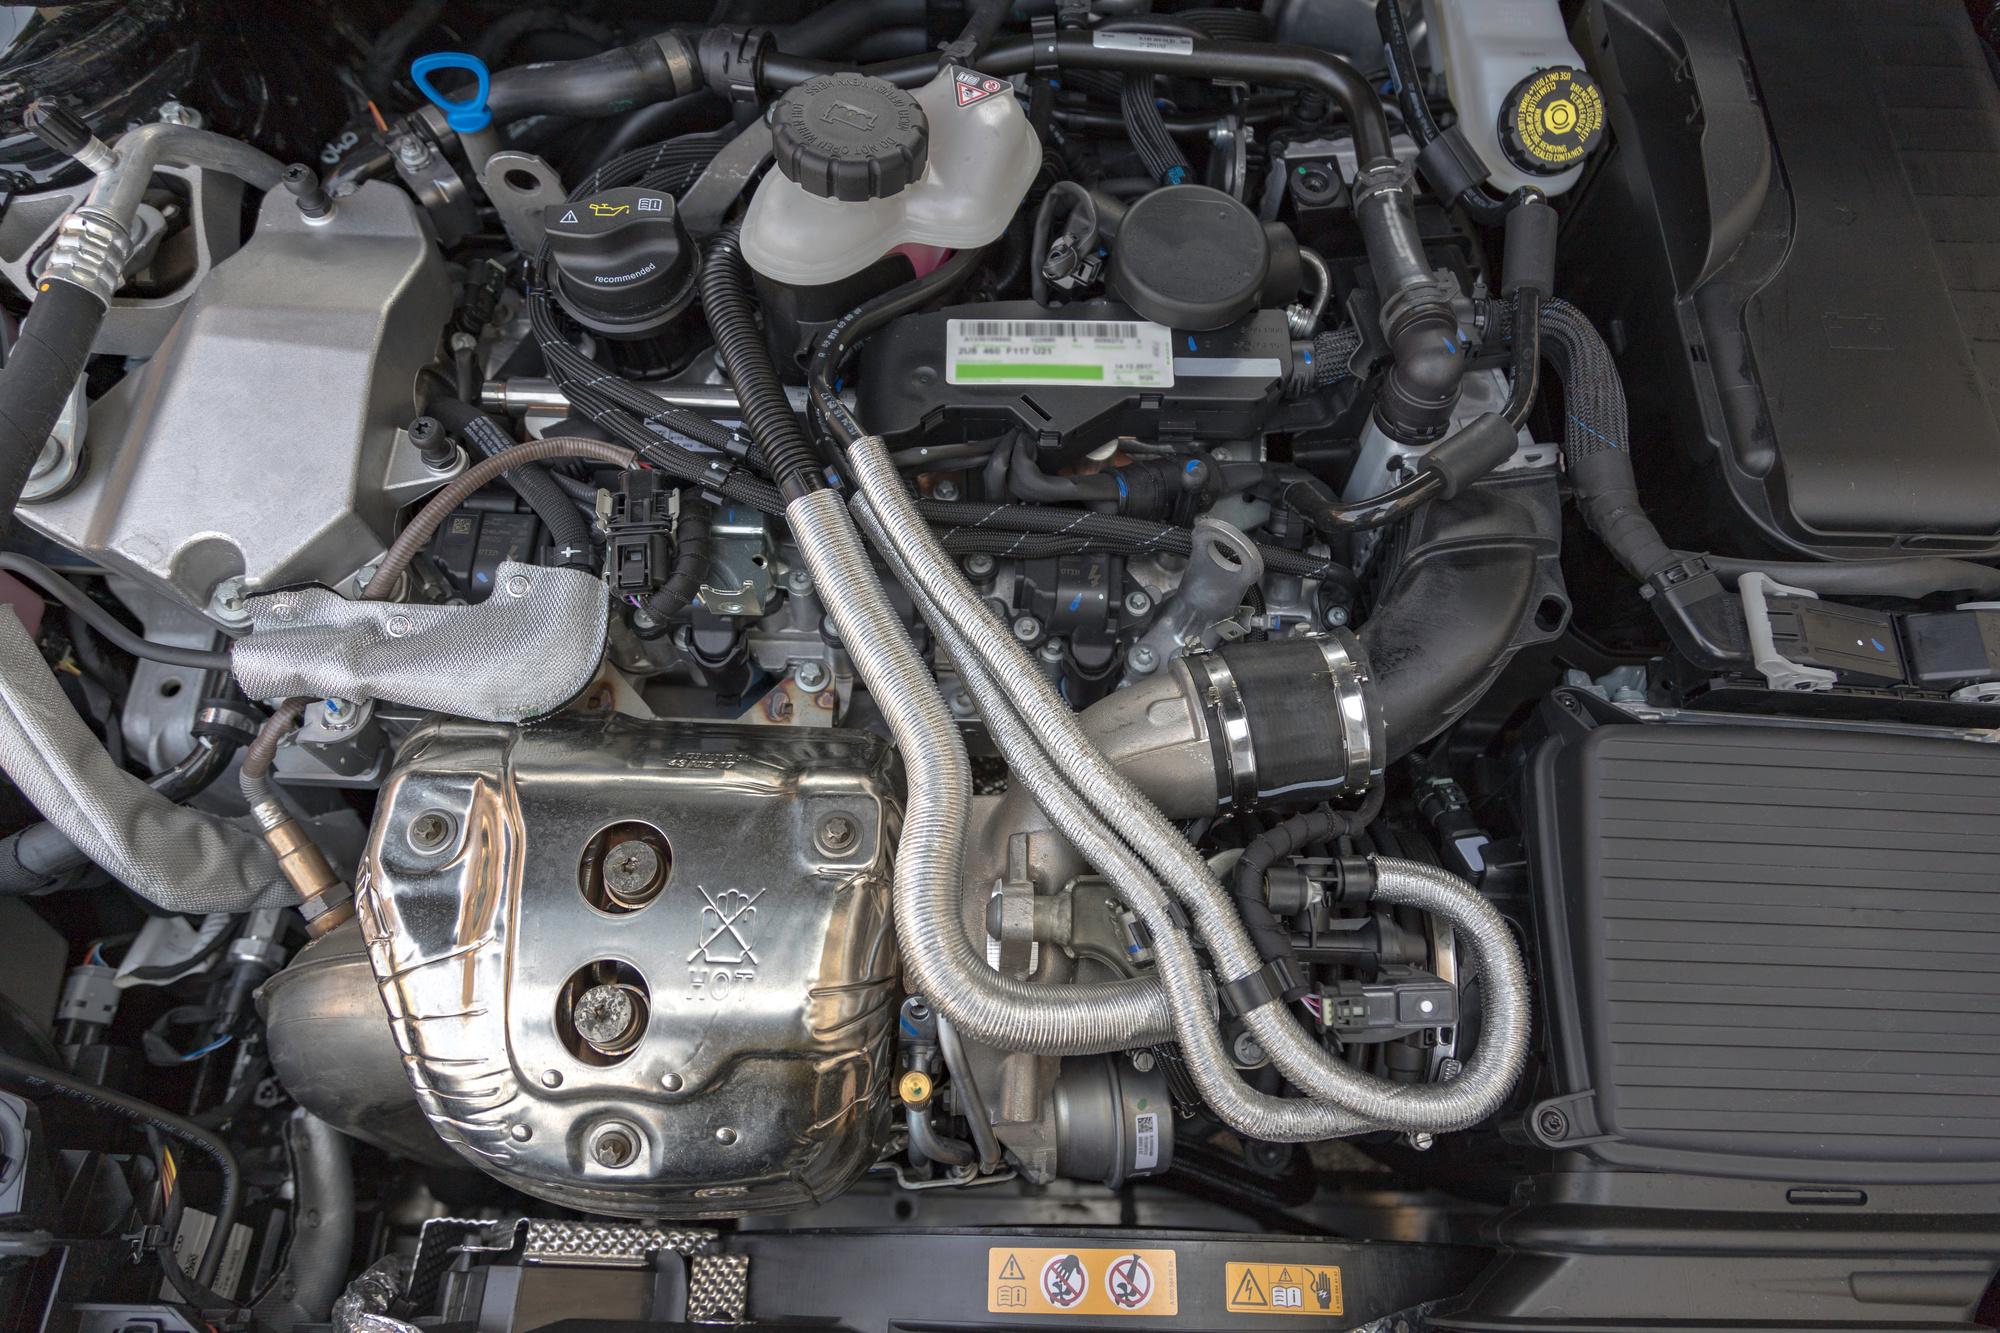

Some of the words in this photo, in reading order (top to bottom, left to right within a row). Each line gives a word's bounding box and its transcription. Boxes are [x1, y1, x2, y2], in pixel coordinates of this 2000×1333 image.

[1545, 72, 1559, 83] ONLY
[1560, 72, 1571, 80] USE
[1537, 82, 1556, 96] CLEAN
[1586, 84, 1598, 99] NUR
[1518, 93, 1531, 113] BRAKE
[1526, 94, 1542, 112] FILLER
[1517, 114, 1526, 131] FLUID
[1533, 147, 1552, 160] SEALED
[1553, 145, 1584, 161] CONTAINER
[594, 262, 656, 283] recommended
[686, 965, 756, 1002] HOT
